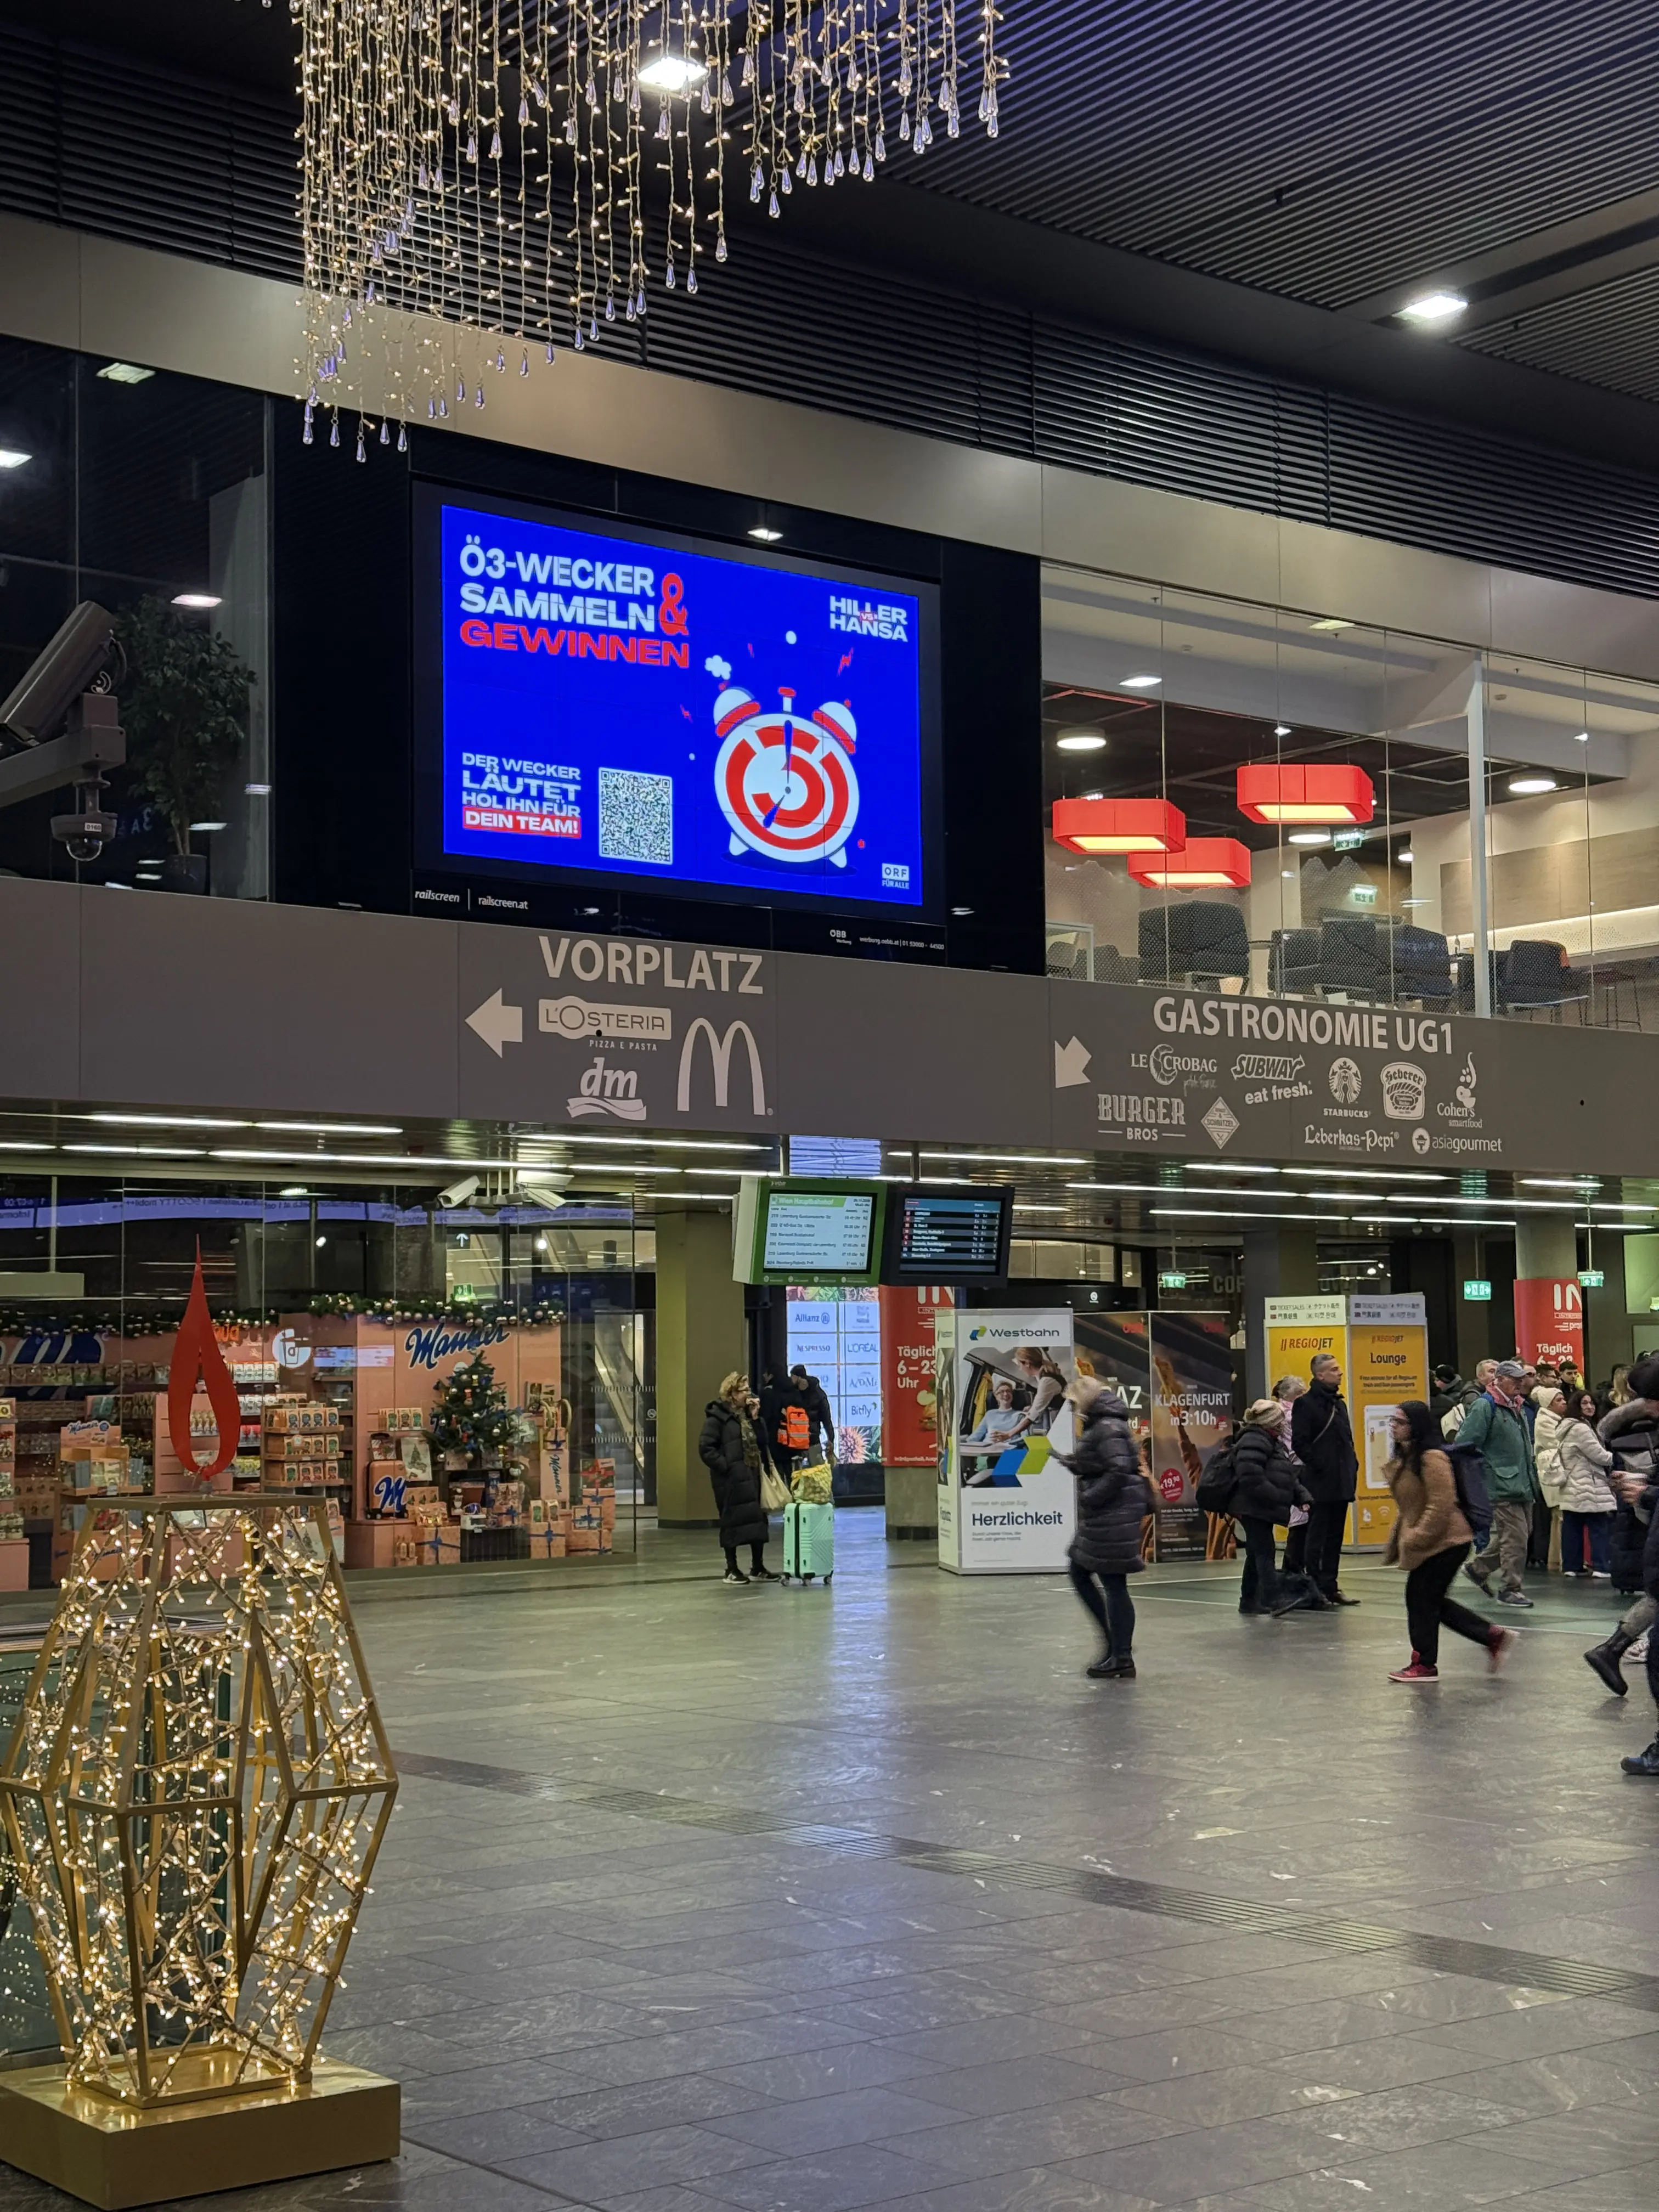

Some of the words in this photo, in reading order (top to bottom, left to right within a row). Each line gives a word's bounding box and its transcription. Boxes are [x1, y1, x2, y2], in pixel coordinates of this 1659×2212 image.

[460, 534, 655, 597] Ö3-WECKER
[460, 583, 655, 632] SAMMELN
[659, 573, 689, 635] &
[830, 595, 909, 625] HILLER
[830, 613, 909, 642] HANSA
[460, 619, 690, 668] GEWINNEN
[462, 752, 499, 769] DER
[502, 758, 582, 781] WECKER
[462, 768, 582, 802] LÄUTET
[462, 791, 502, 809] HOL
[505, 795, 540, 814] IHN
[542, 797, 581, 817] FÜR
[465, 810, 514, 828] DEIN
[516, 815, 579, 835] TEAM!
[884, 867, 907, 878] ORF
[414, 889, 460, 903] railscreen
[478, 895, 529, 910] railscreen.at
[538, 935, 763, 995] VORPLATZ
[1153, 996, 1388, 1049] GASTRONOMIE
[1396, 1016, 1453, 1054] UG1
[589, 1039, 616, 1048] PIZZA
[629, 1042, 657, 1052] PASTA
[1131, 1053, 1148, 1068] LE
[1163, 1056, 1218, 1073] CROBAG
[1232, 1054, 1305, 1081] SUBWAY
[580, 1057, 637, 1098] dm
[1245, 1088, 1268, 1104] eat
[1098, 1093, 1186, 1125] BURGER
[1323, 1108, 1369, 1118] STARBUCKS
[1437, 1102, 1475, 1118] Cohen's
[1126, 1127, 1159, 1142] BROS
[1304, 1124, 1395, 1152] Leberkas-Pepi
[1432, 1134, 1503, 1154] asiagourmet
[795, 1314, 820, 1322] Allianz
[989, 1328, 1060, 1337] Westbahn
[405, 1323, 510, 1370] Manner
[1289, 1337, 1334, 1351] REGIOJET
[1536, 1342, 1573, 1356] Täglich
[897, 1359, 907, 1375] 6
[1370, 1352, 1407, 1366] Lounge
[897, 1376, 920, 1389] Uhr
[1155, 1393, 1230, 1407] KLAGENFURT
[851, 1404, 872, 1418] Bitfly
[972, 1510, 1063, 1526] Herzlichkeit
